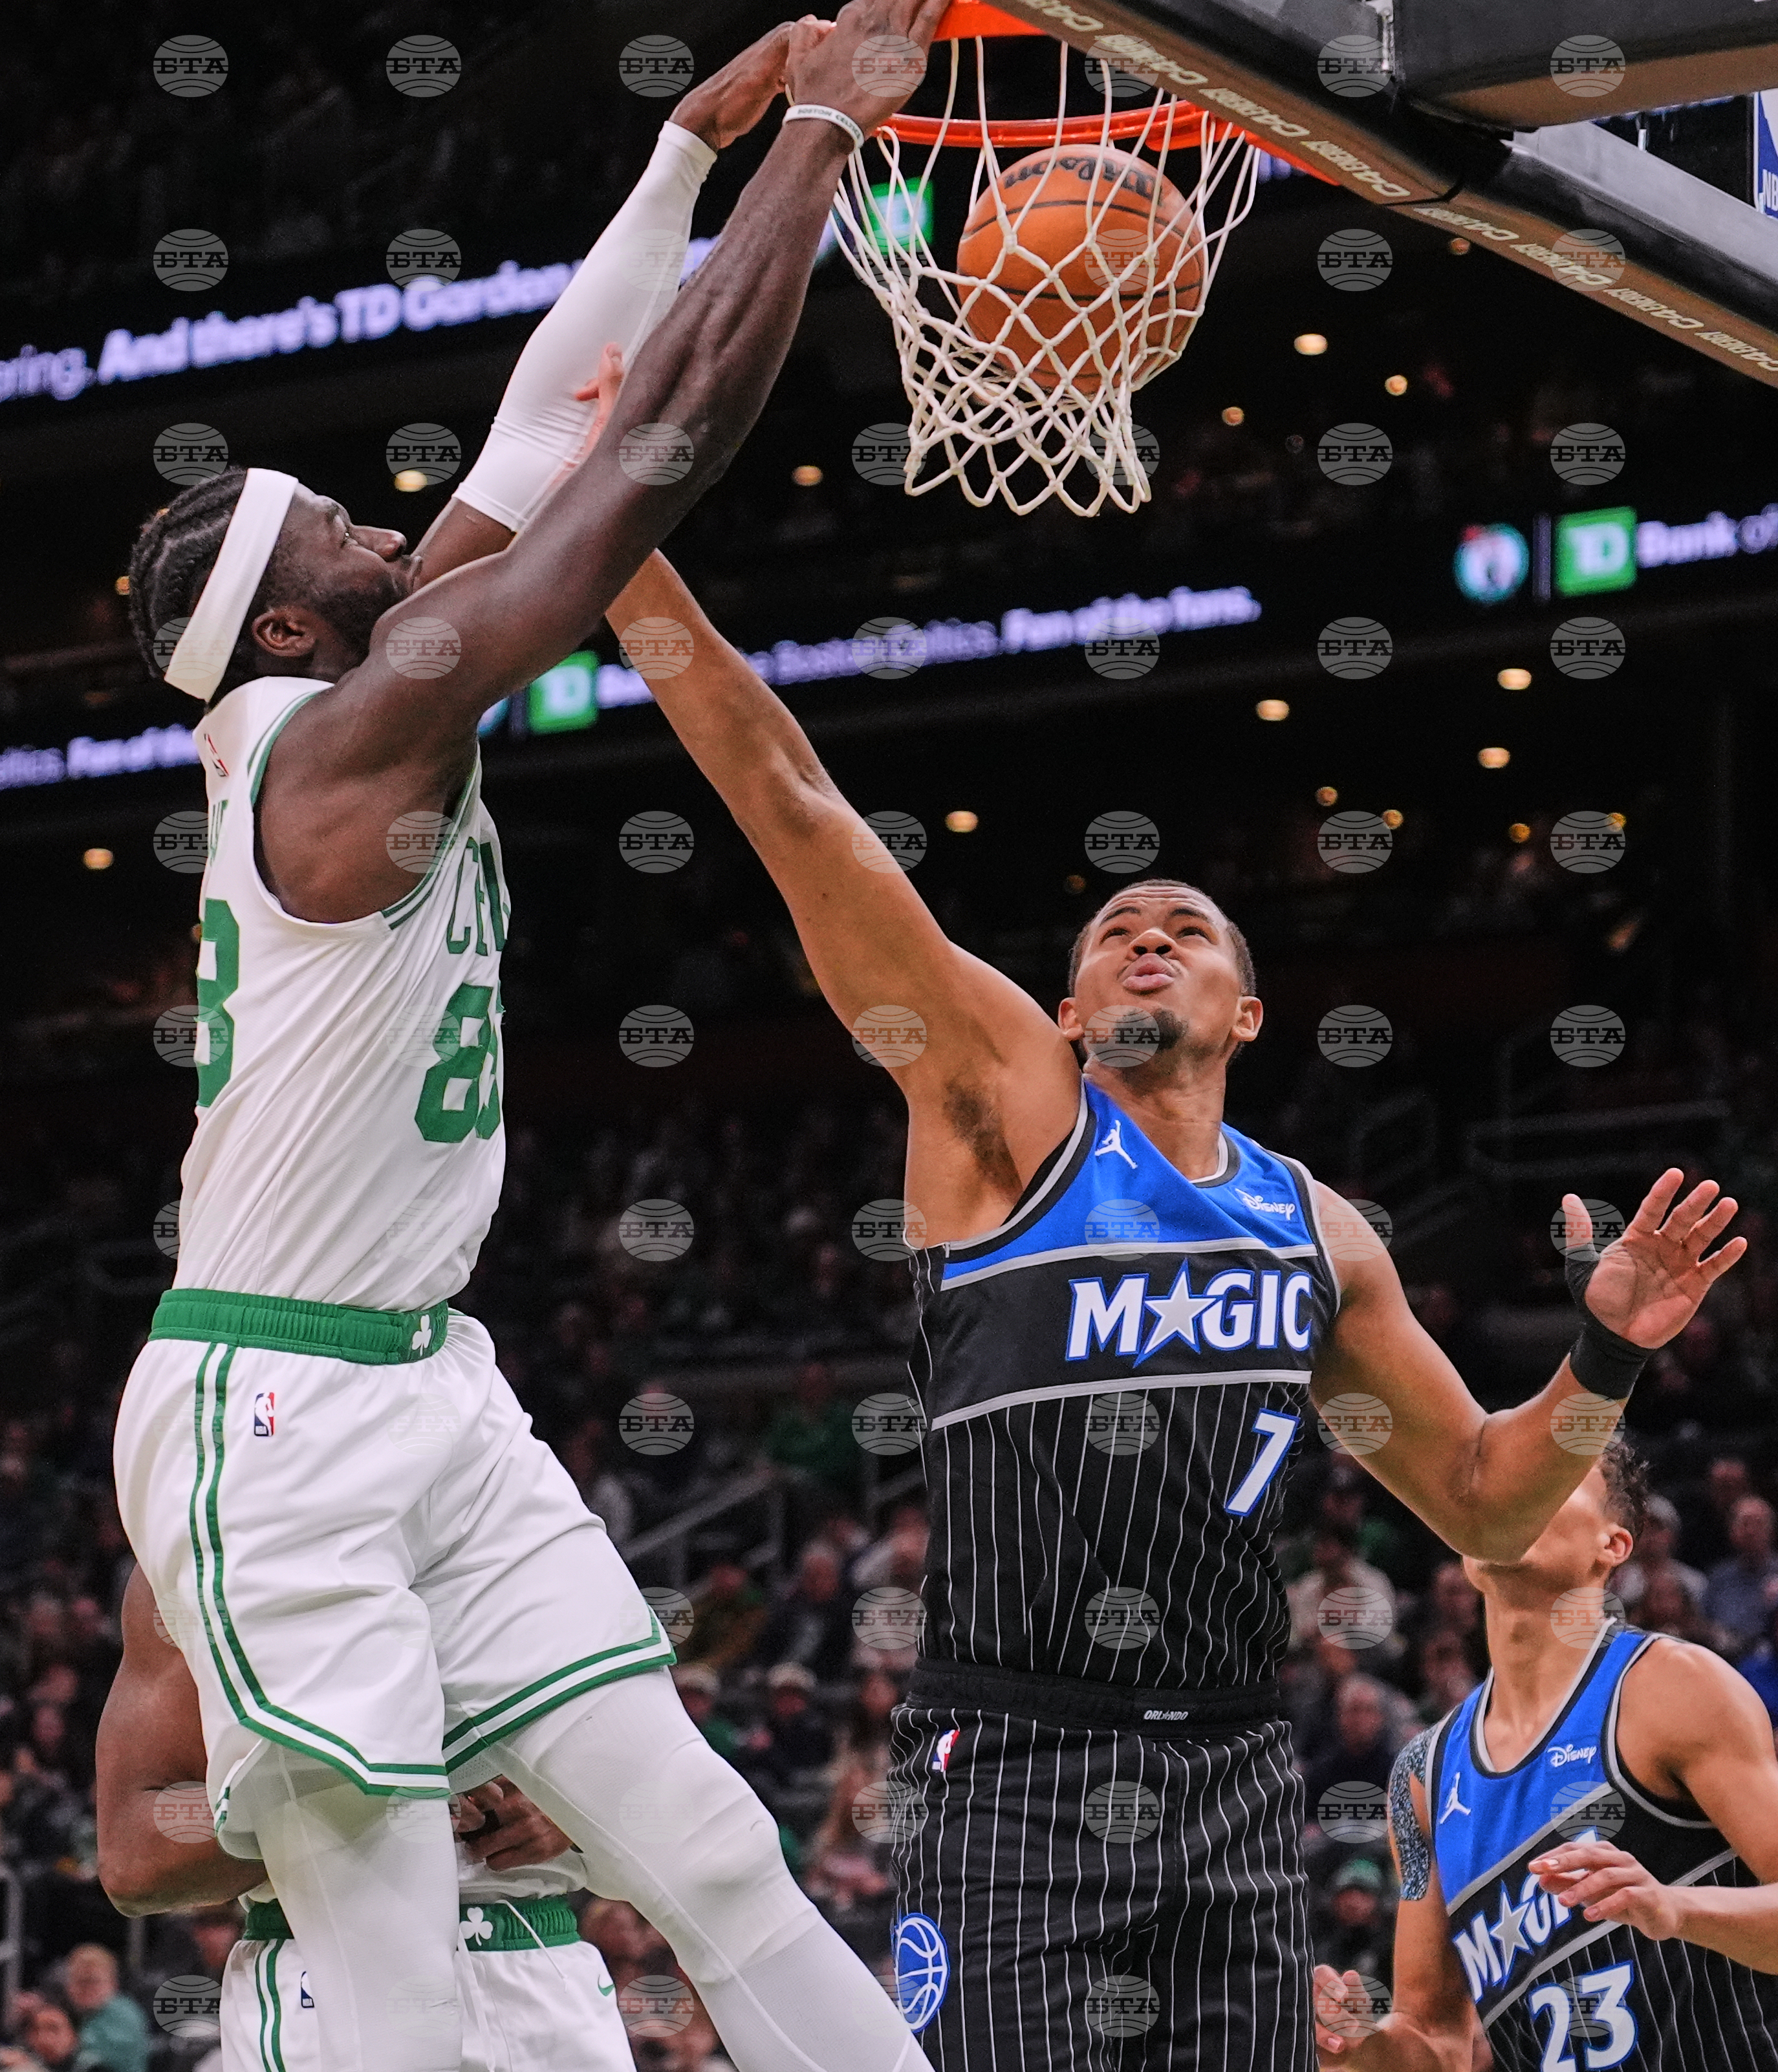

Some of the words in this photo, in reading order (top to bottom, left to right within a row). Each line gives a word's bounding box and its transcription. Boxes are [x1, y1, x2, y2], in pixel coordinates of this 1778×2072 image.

[1251, 113, 1310, 137] C4
[1004, 156, 1162, 206] Wilson
[1353, 169, 1411, 197] C4
[1464, 222, 1519, 241] C4
[1558, 264, 1612, 285] C4
[97, 329, 190, 387] And
[190, 295, 338, 369] there's
[335, 285, 402, 343] TD
[1650, 309, 1705, 329] C4
[1568, 521, 1629, 576] TD
[1224, 1407, 1301, 1517] 7
[1530, 1960, 1638, 2072] 23
